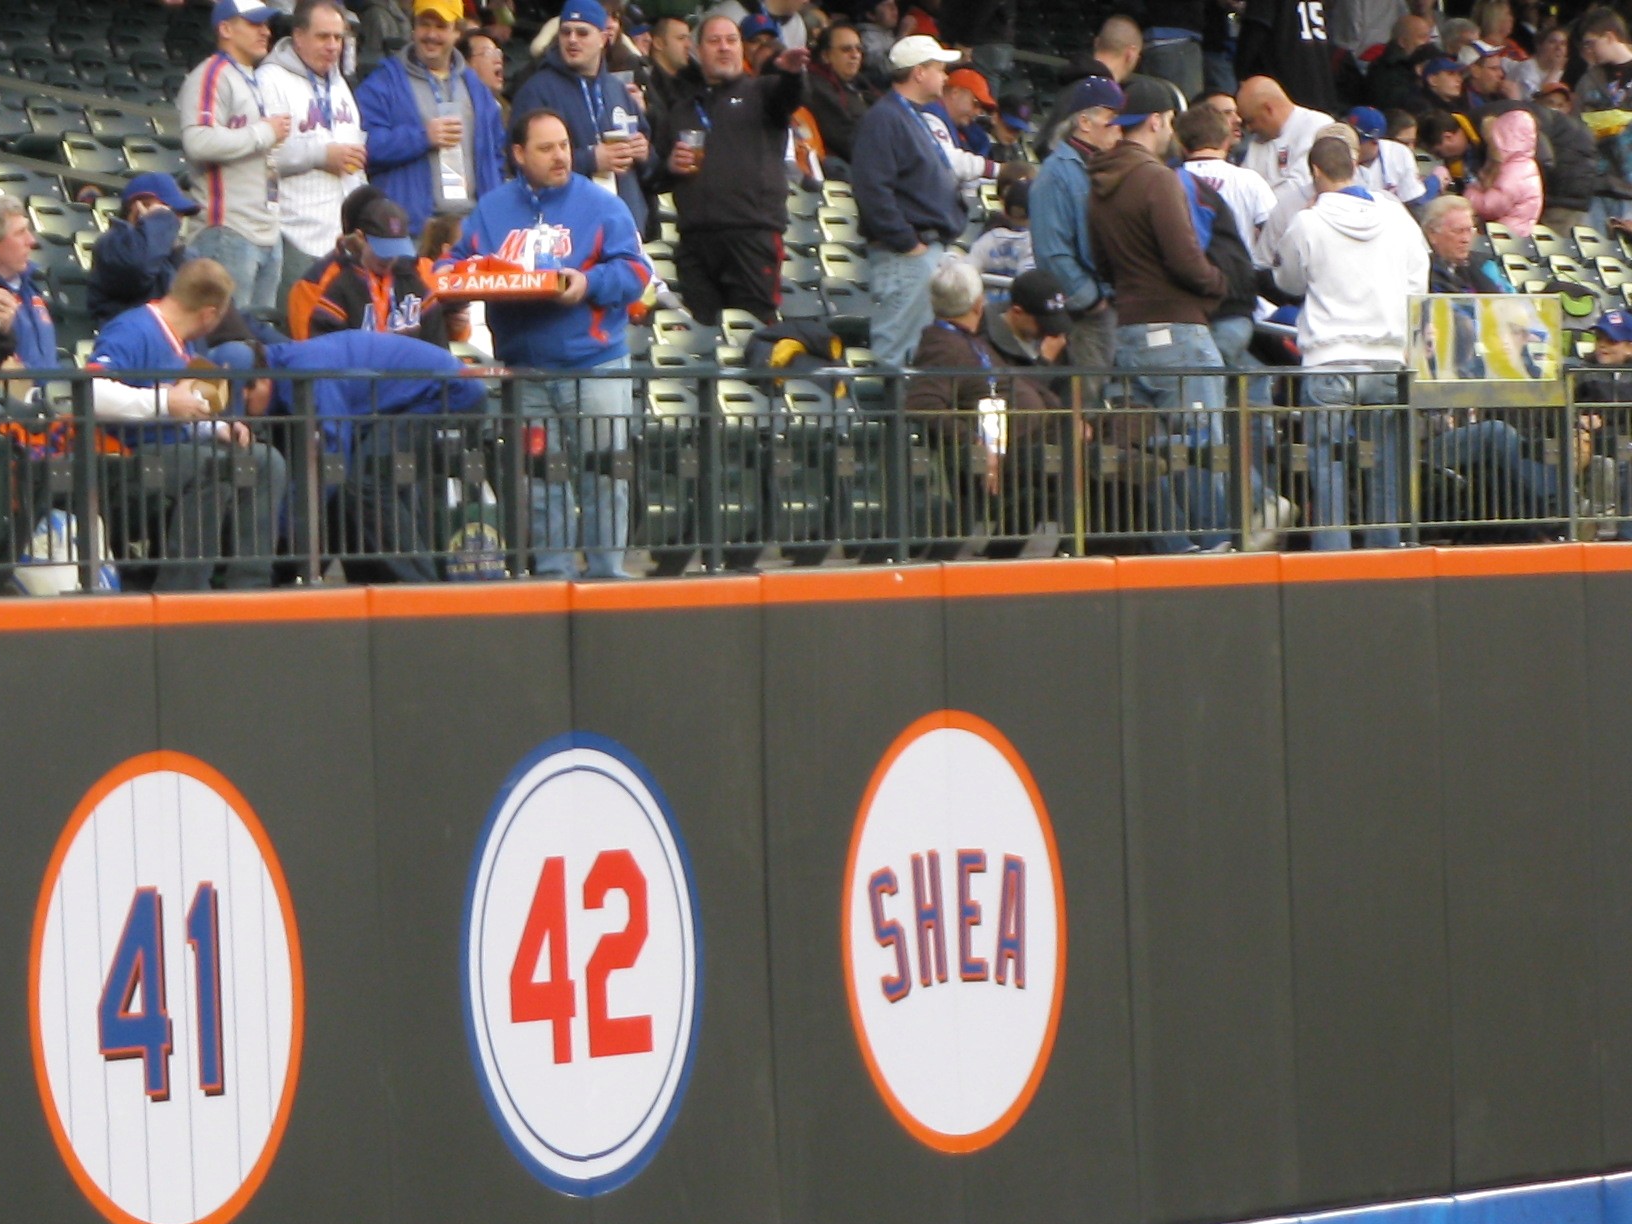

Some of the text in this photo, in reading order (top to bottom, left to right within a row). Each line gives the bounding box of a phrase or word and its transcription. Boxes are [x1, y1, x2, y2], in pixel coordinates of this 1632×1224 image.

[467, 274, 547, 290] AMAZIN'
[98, 881, 226, 1101] 41
[509, 849, 653, 1064] 42
[868, 848, 1026, 1004] SHEA
